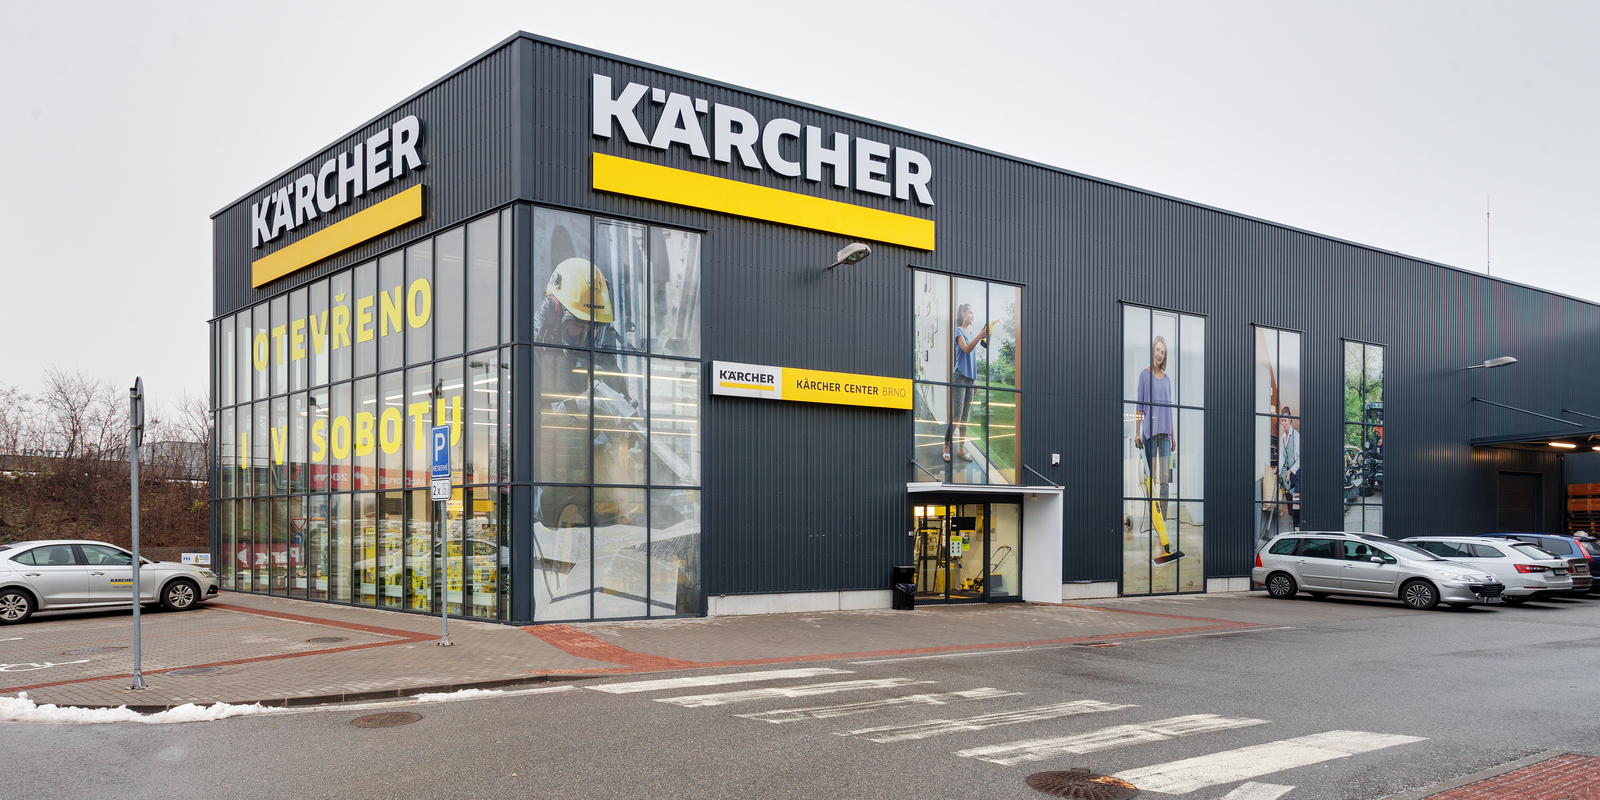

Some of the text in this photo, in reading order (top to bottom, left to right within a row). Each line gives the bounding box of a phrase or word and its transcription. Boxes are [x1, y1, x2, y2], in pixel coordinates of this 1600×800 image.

[592, 73, 935, 206] KÄRCHER
[252, 115, 423, 249] KÄRCHER
[253, 277, 432, 372] OTEVŘENO
[719, 369, 774, 384] KÄRCHER
[796, 378, 906, 398] KÄRCHER CENTER BRNO
[270, 425, 287, 465] V
[434, 433, 446, 462] P
